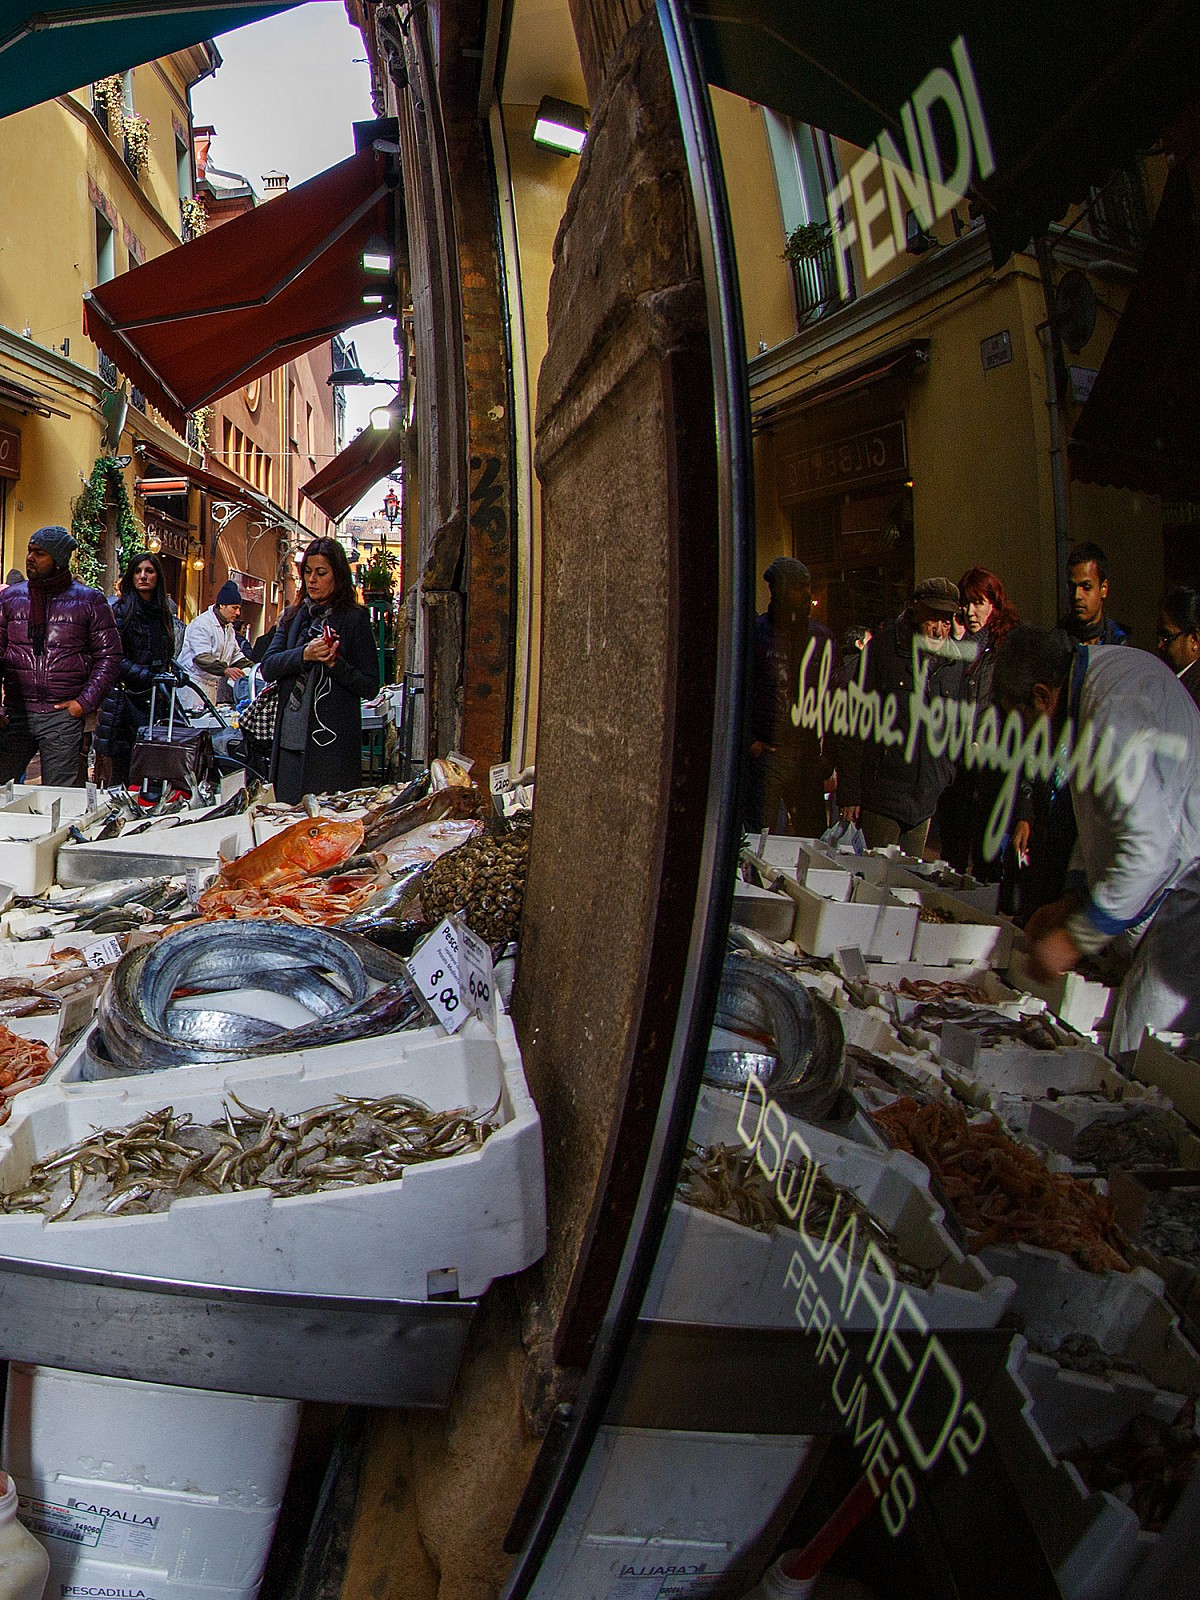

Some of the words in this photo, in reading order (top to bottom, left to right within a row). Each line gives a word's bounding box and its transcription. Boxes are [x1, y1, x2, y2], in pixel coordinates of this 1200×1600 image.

[826, 35, 996, 301] FENDI
[791, 636, 901, 746] Salvatore
[905, 634, 1186, 862] Ferragamo
[783, 1251, 917, 1537] PERFUMES
[74, 1522, 100, 1535] 149060
[75, 1502, 154, 1526] CABALLA
[65, 1586, 145, 1598] PESCADILLA
